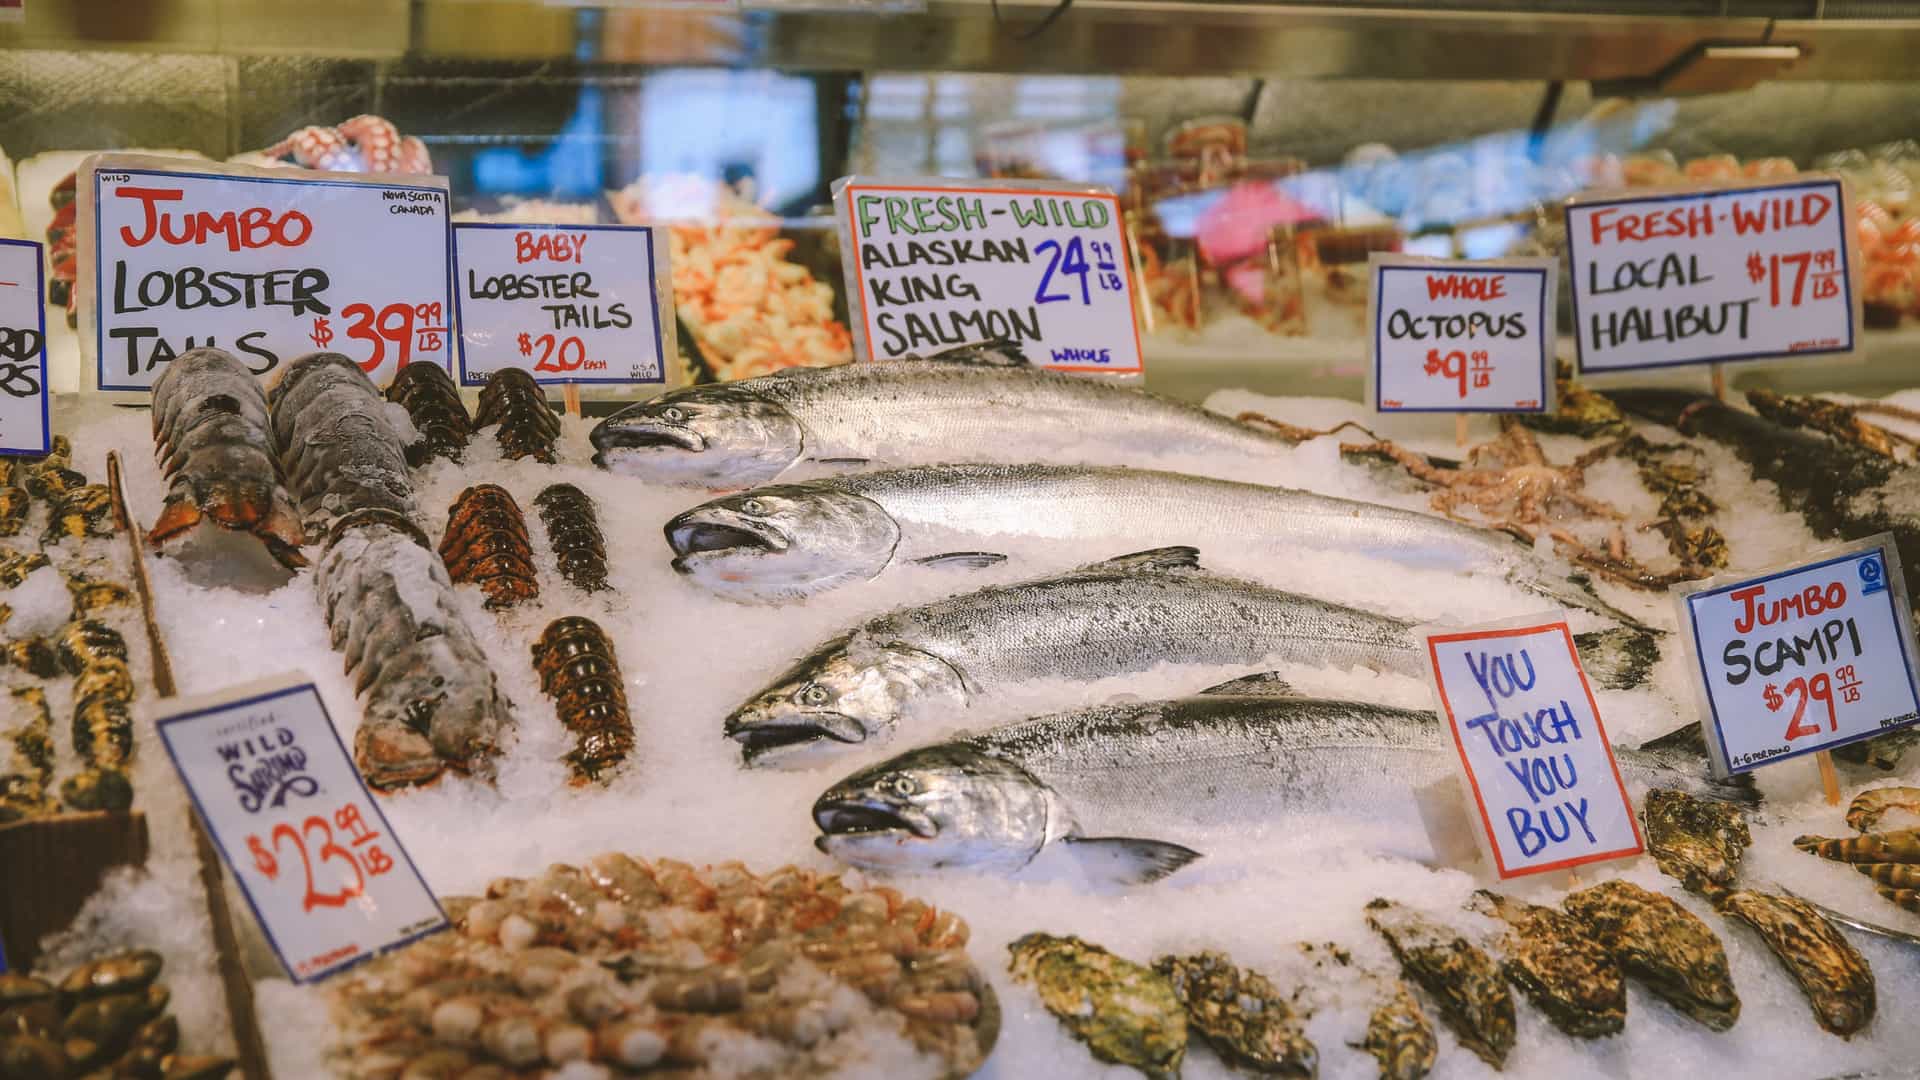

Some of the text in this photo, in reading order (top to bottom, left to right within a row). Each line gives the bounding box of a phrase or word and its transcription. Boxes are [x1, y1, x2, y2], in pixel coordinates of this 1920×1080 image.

[382, 191, 407, 200] NOVA
[390, 205, 434, 215] CANADA
[115, 187, 313, 252] JUMBO
[515, 231, 587, 264] BABY
[862, 237, 1030, 270] ALASKAN
[113, 260, 331, 316] LOBSTER
[468, 269, 599, 300] LOBSTER
[1033, 236, 1091, 305] 24
[1098, 273, 1122, 290] LB
[1426, 275, 1507, 301] WHOLE
[1589, 252, 1714, 296] LOCAL
[1746, 251, 1812, 308] $17
[1813, 278, 1840, 299] LB
[869, 274, 981, 307] KING
[541, 303, 632, 330] TAILS
[877, 306, 1042, 357] SALMON
[1387, 308, 1527, 339] OCTOPUS
[1591, 297, 1760, 351] HALIBUT
[418, 333, 442, 352] LB
[517, 332, 607, 373] $20 EACH
[1473, 373, 1490, 388] LB
[1730, 582, 1847, 634] JUMBO
[1723, 617, 1863, 685] SCAMPI
[1464, 649, 1536, 712] YOU
[1843, 687, 1861, 703] LB
[1762, 672, 1838, 742] $29
[217, 728, 294, 762] WILD
[1465, 700, 1582, 757] TOUCH
[1505, 753, 1578, 804] YOU
[1506, 798, 1597, 858] BUY
